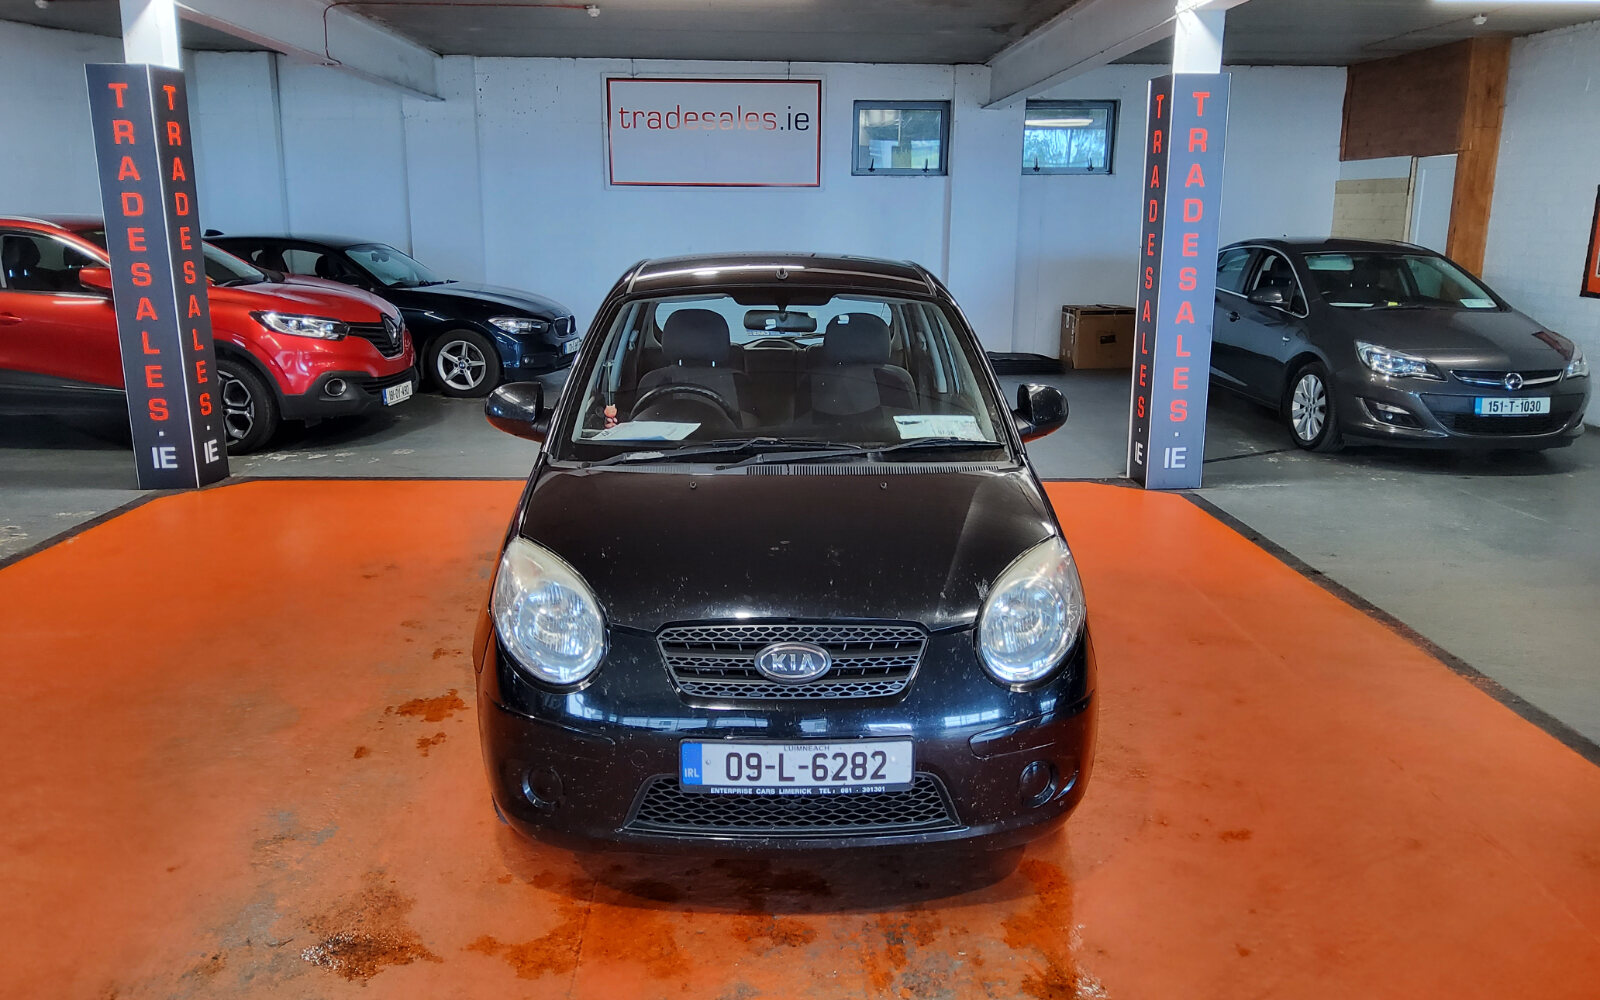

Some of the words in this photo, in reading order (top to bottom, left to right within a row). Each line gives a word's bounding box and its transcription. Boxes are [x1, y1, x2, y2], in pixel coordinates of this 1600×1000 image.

[619, 104, 810, 131] tradesales.ie
[1488, 401, 1541, 412] 151-T-1030
[771, 653, 816, 671] KIA
[783, 744, 830, 752] LUIMNEACH
[684, 767, 700, 778] IRL
[725, 751, 887, 782] 09-L-6282
